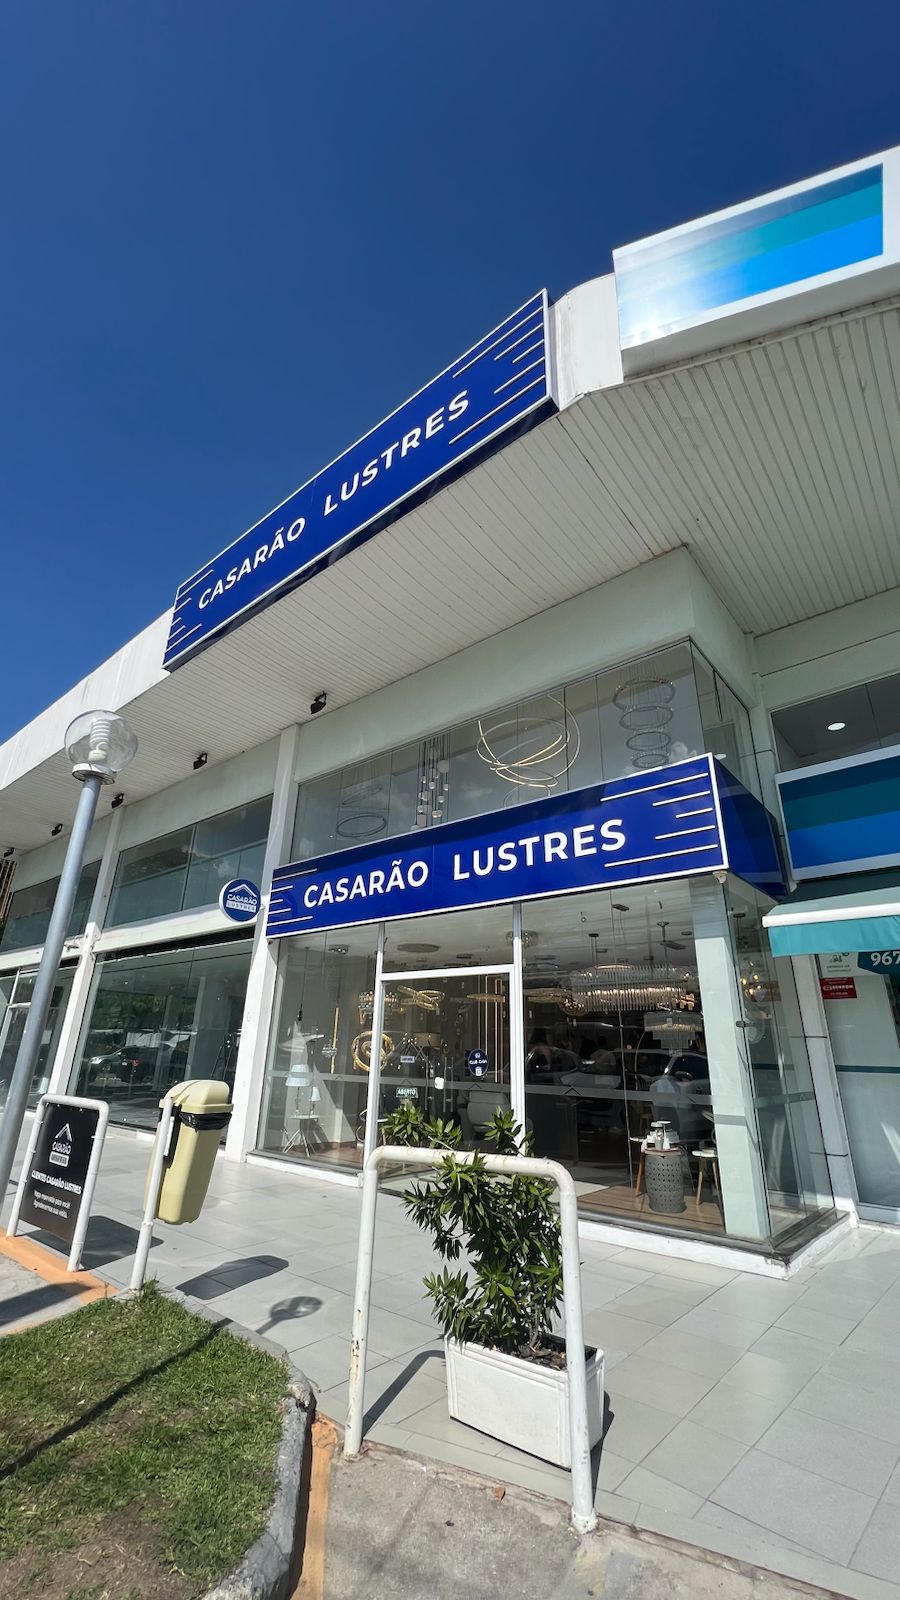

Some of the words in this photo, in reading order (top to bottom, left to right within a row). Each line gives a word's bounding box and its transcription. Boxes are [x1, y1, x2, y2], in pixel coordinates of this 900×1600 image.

[198, 517, 306, 609] CASARÃO
[323, 390, 469, 516] LUSTRES
[303, 859, 429, 908] CASARÃO
[453, 818, 626, 881] LUSTRES
[227, 894, 257, 905] CASARÃO
[227, 901, 255, 911] LUSTRES
